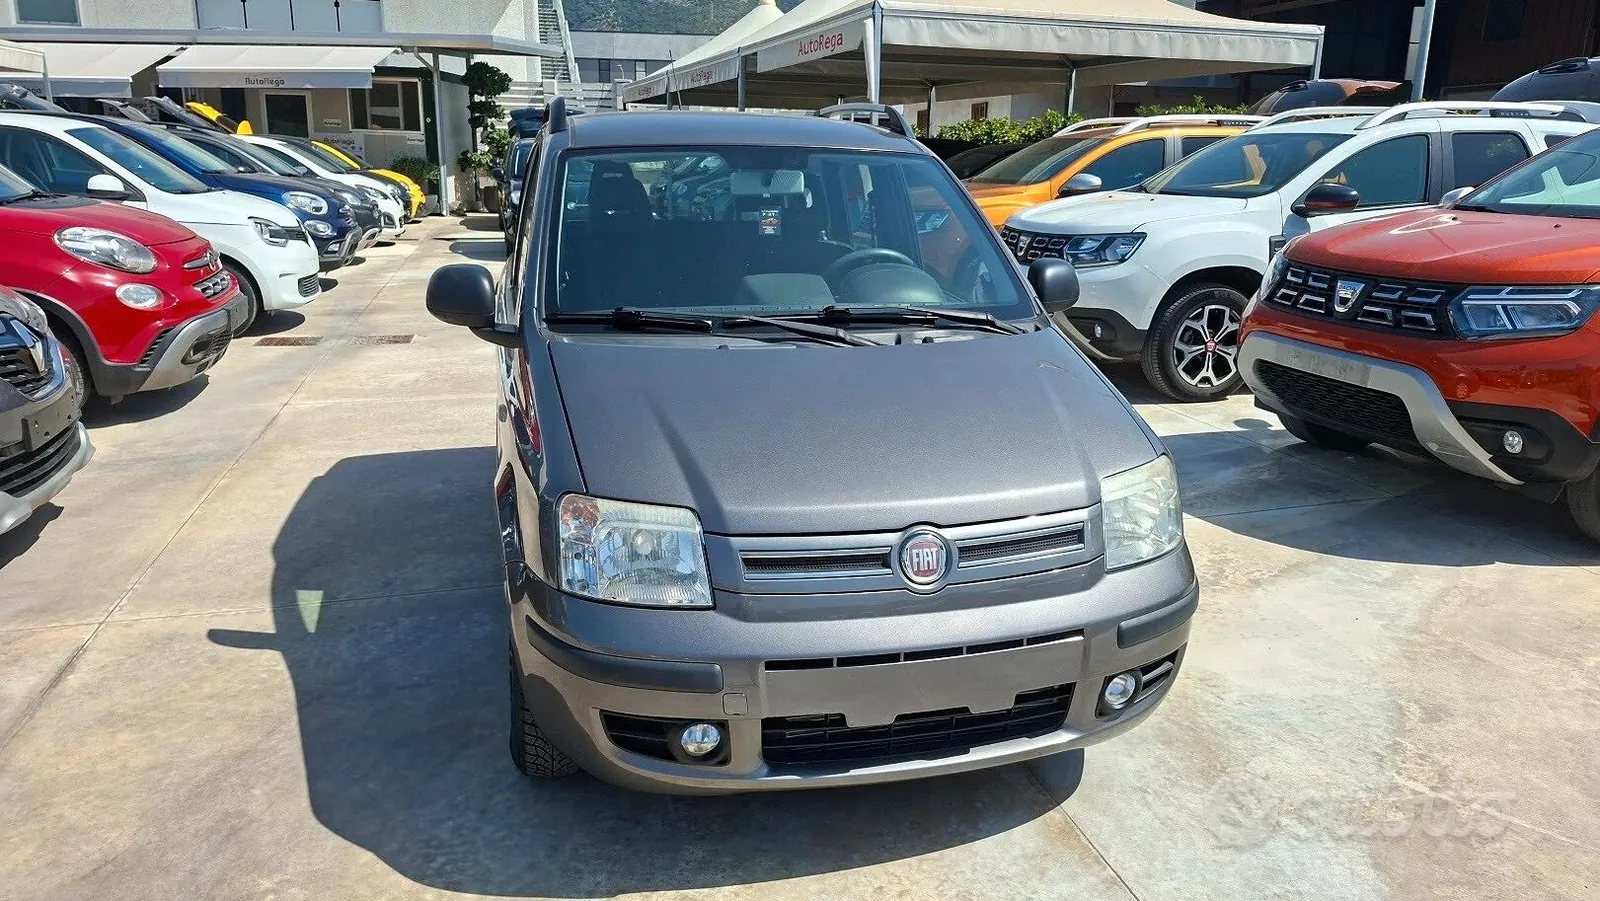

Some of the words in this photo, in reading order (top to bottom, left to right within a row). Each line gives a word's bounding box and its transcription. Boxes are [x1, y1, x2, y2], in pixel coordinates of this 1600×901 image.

[797, 32, 844, 57] AutoRega
[244, 77, 285, 87] AutoRega
[912, 547, 938, 571] FIAT
